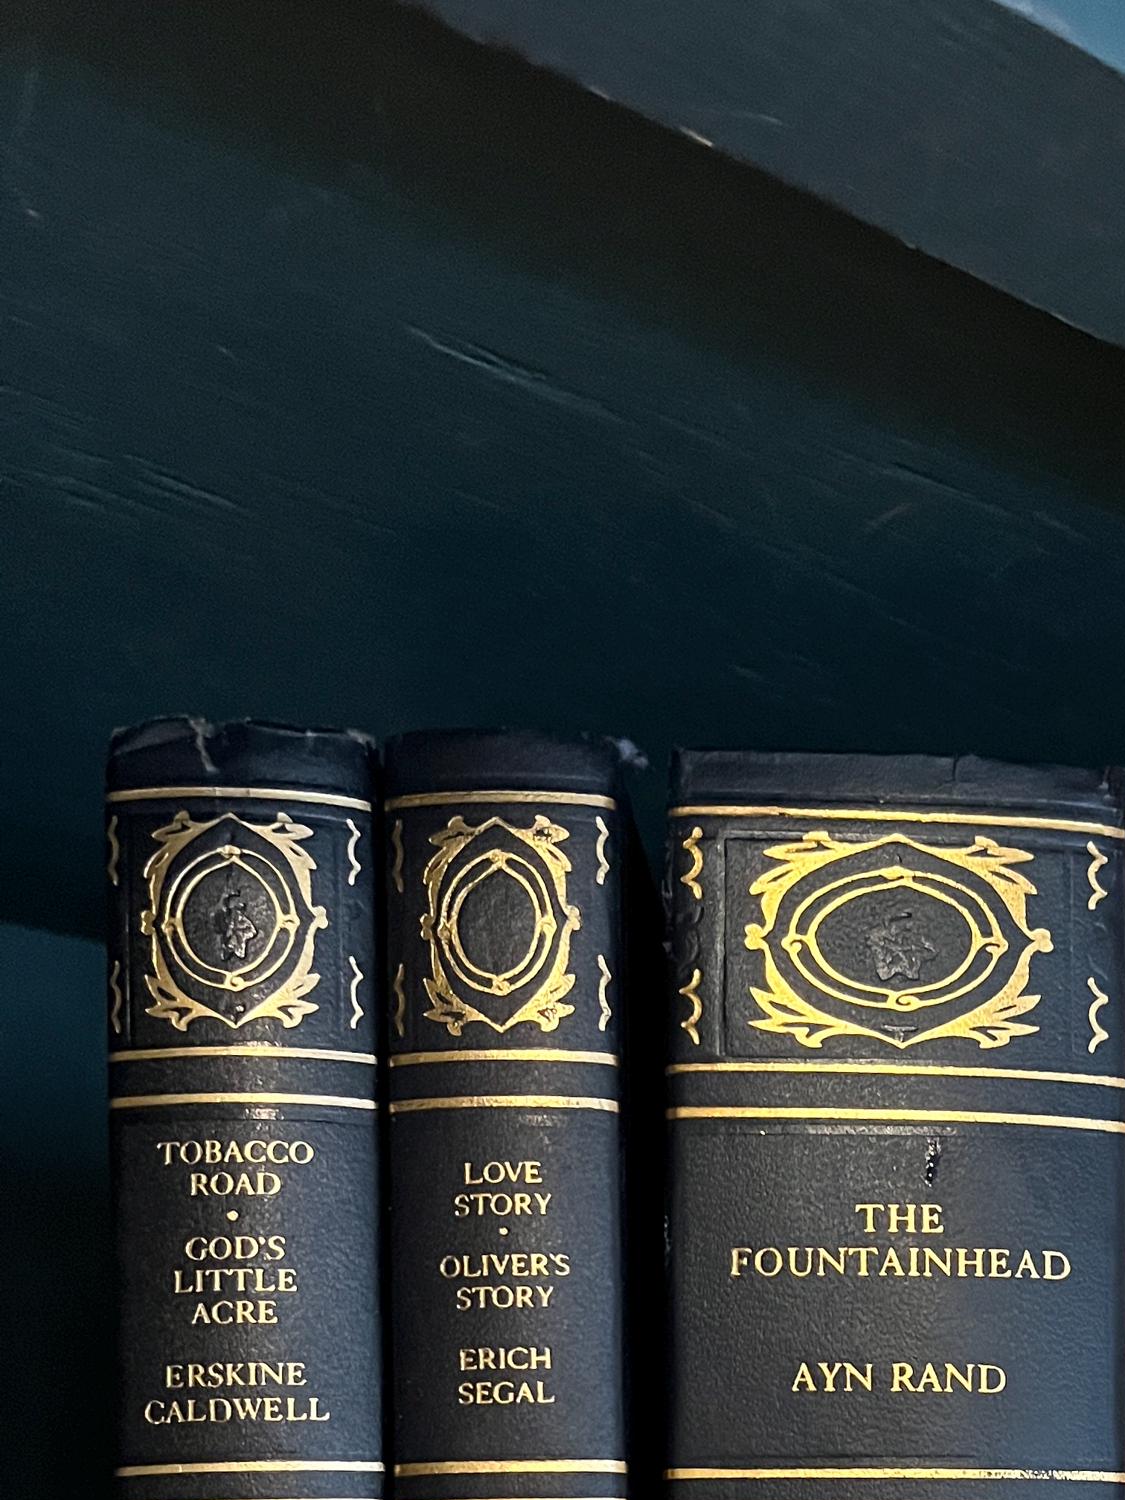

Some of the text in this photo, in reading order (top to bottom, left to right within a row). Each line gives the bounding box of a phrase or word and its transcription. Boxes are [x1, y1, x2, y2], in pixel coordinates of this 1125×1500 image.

[157, 1140, 314, 1165] TOBACCO
[190, 1172, 281, 1196] ROAD
[464, 1161, 543, 1185] LOVE
[454, 1194, 552, 1217] STORY
[855, 1204, 945, 1234] THE
[185, 1235, 286, 1260] GOD'S
[440, 1253, 571, 1278] OLIVER'S
[730, 1247, 1072, 1280] FOUNTAINHEAD
[174, 1268, 298, 1294] LITTLE
[456, 1286, 554, 1310] STORY
[191, 1301, 278, 1325] ACRE
[459, 1347, 552, 1372] ERICH
[165, 1362, 307, 1388] ERSKINE
[791, 1362, 1008, 1394] AYN RAND
[458, 1381, 556, 1405] SEGAL
[144, 1398, 331, 1425] CALDWELL
